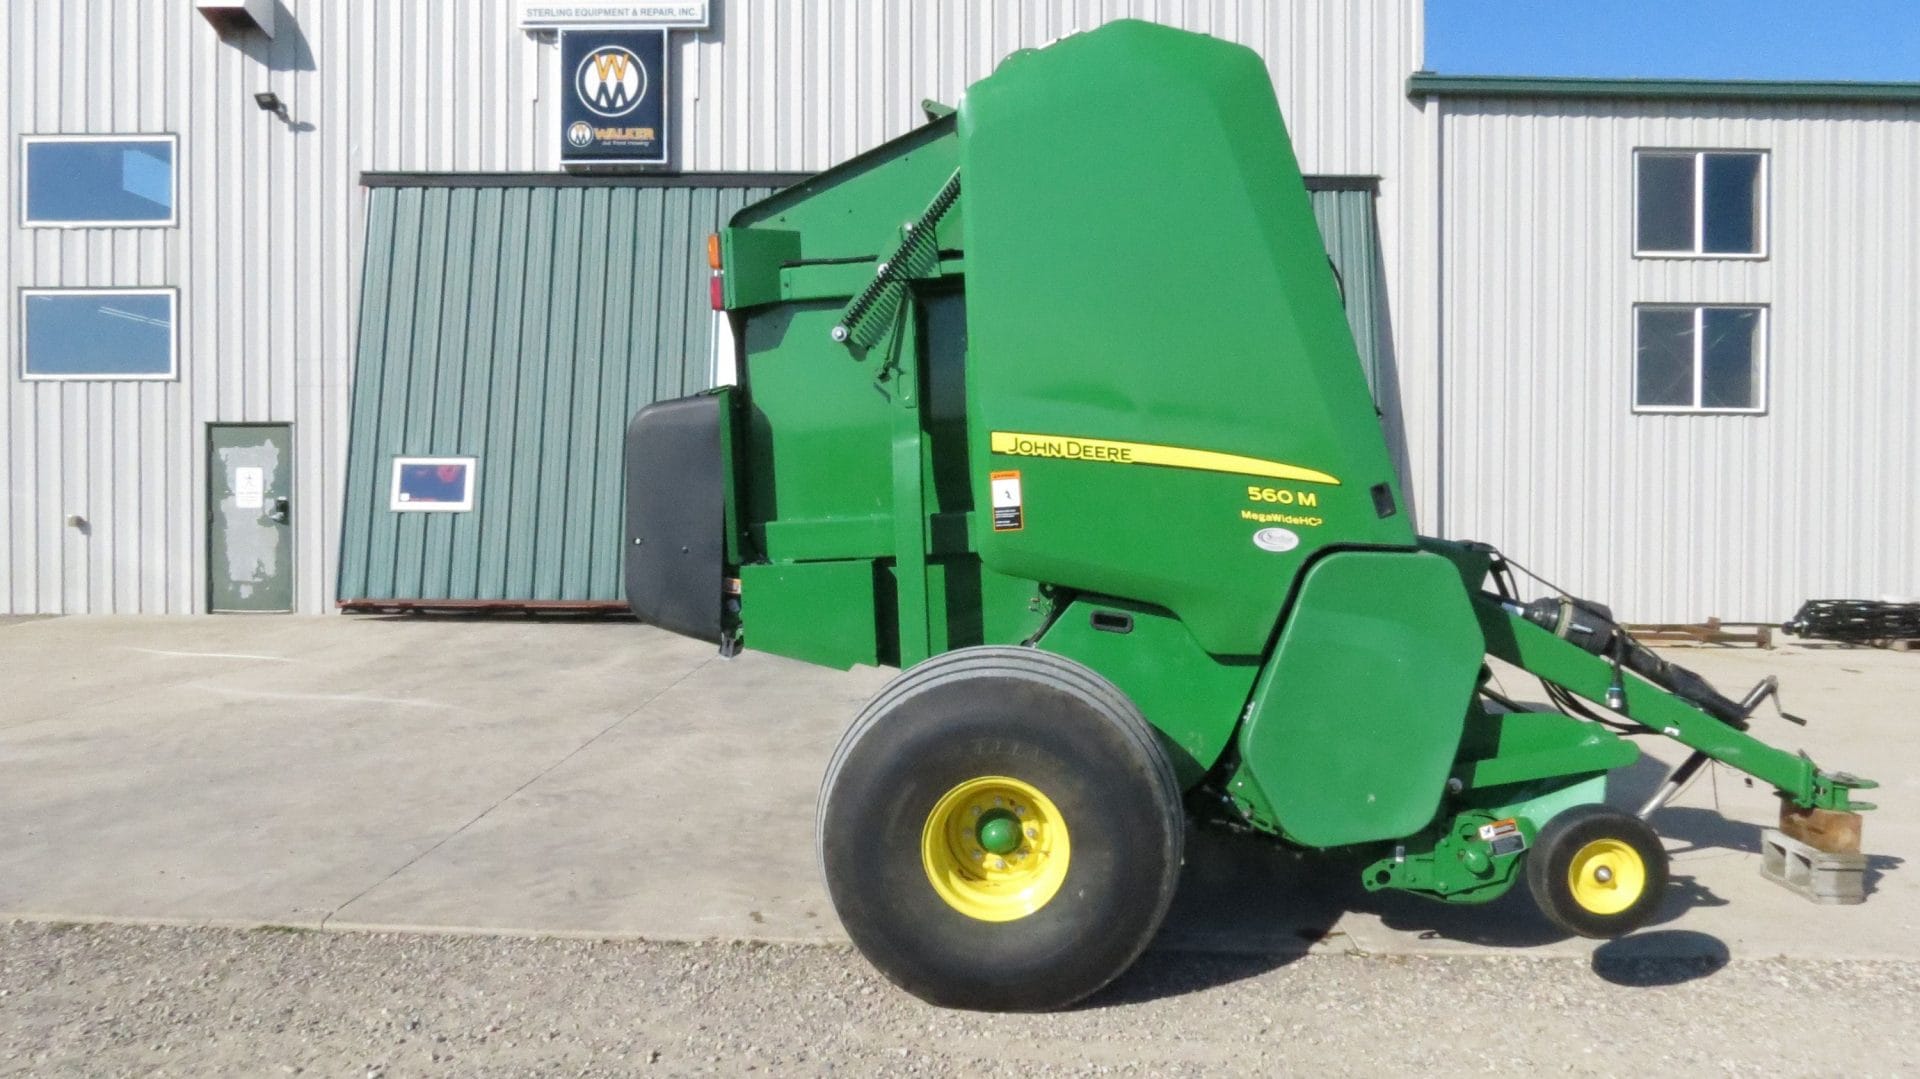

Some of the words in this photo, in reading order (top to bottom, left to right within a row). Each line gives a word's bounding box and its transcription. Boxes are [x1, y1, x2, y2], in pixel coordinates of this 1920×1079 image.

[526, 8, 573, 17] STERLING
[575, 8, 629, 17] EQUIPMENT
[632, 8, 638, 17] &
[678, 8, 698, 17] INC.
[594, 127, 655, 141] WALKER
[1008, 437, 1062, 455] JOHN
[1066, 441, 1132, 461] DEERE
[1247, 486, 1294, 504] 560
[1297, 492, 1317, 507] M
